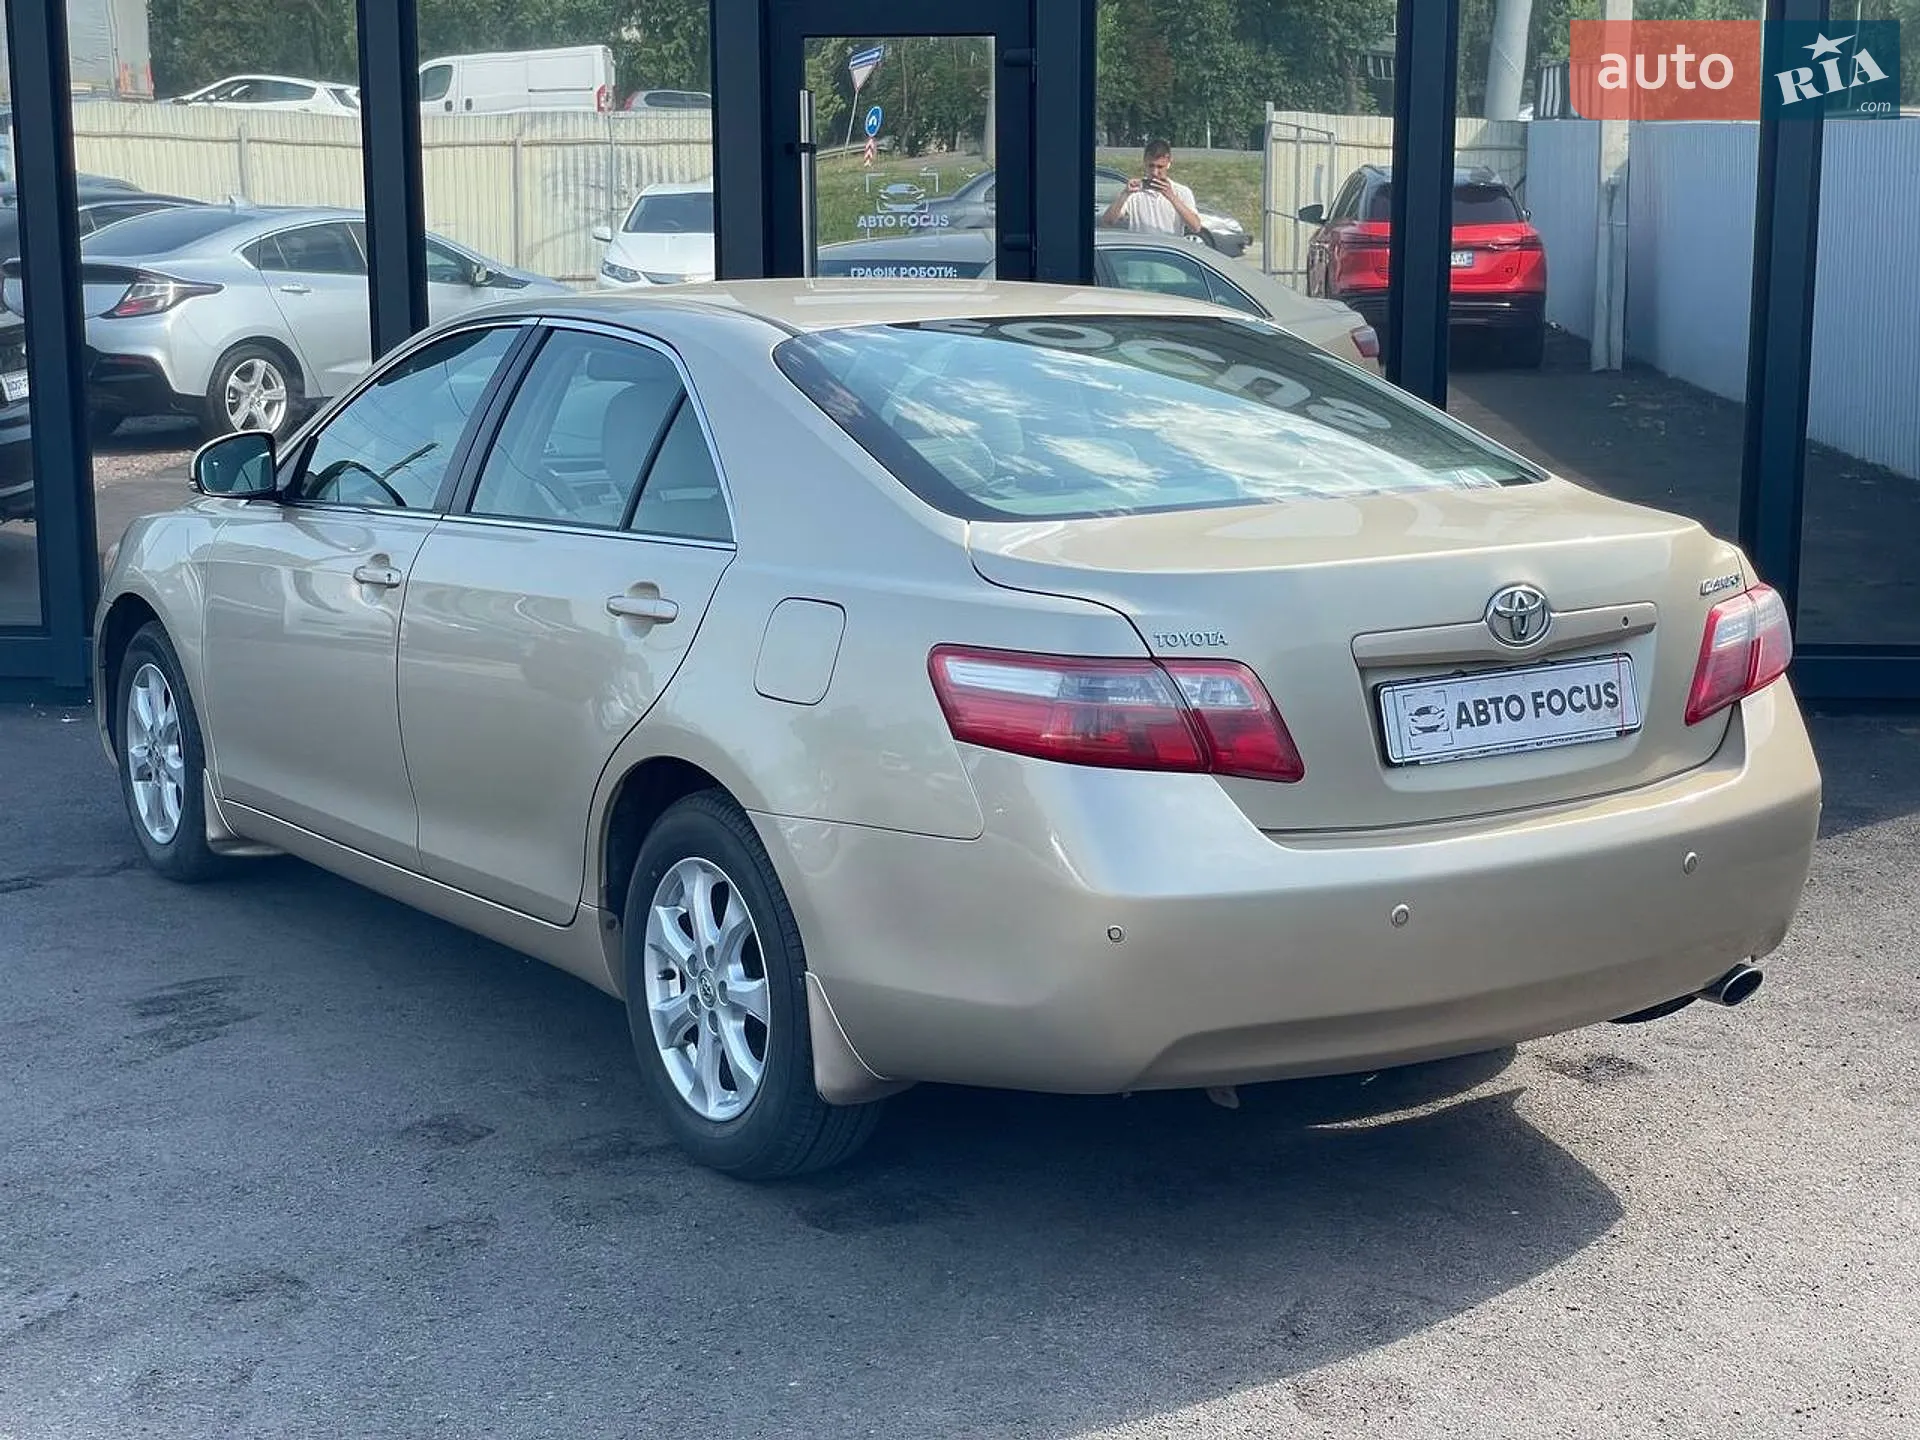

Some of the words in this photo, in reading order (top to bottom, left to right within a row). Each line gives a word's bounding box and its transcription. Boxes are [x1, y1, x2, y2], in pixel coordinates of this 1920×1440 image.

[857, 214, 896, 228] АВТО
[900, 214, 950, 228] FOCUS
[850, 267, 897, 278] ГРАФІК
[900, 266, 958, 278] РОБОТИ:
[1153, 631, 1229, 648] TOYOTA
[1455, 694, 1526, 730] АВТО
[1531, 680, 1620, 718] FOCUS
